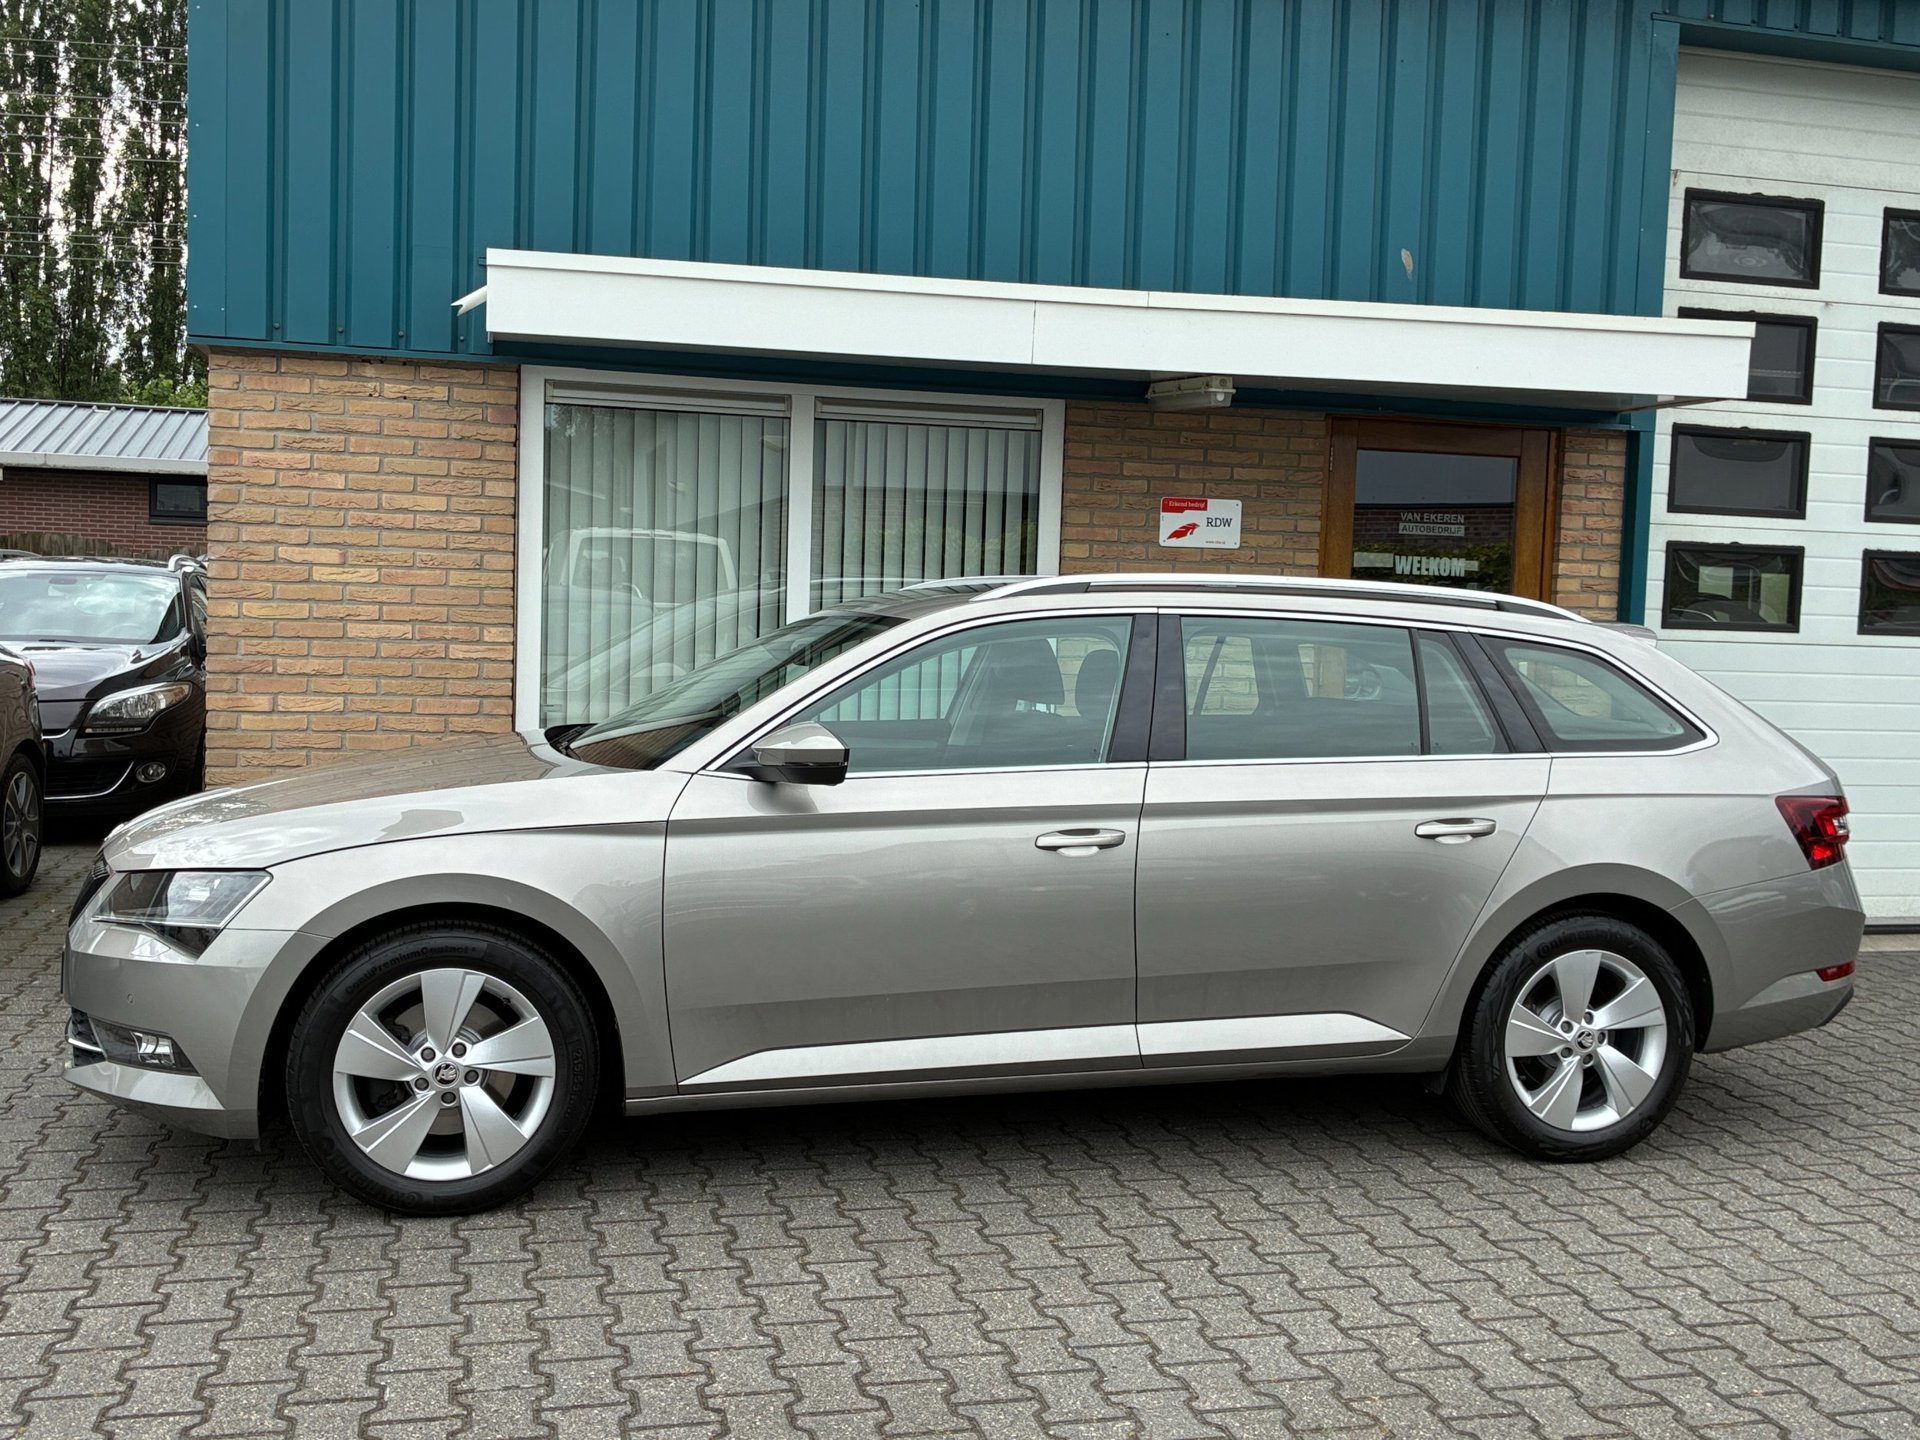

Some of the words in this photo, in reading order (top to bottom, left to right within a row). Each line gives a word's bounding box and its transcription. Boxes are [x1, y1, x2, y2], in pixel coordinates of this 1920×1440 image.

[1206, 517, 1233, 527] RDW
[1400, 511, 1420, 522] VAN
[1423, 512, 1465, 523] EKEREN
[1401, 524, 1463, 535] AUTOBEDRIJF
[1394, 555, 1466, 577] WELKOM
